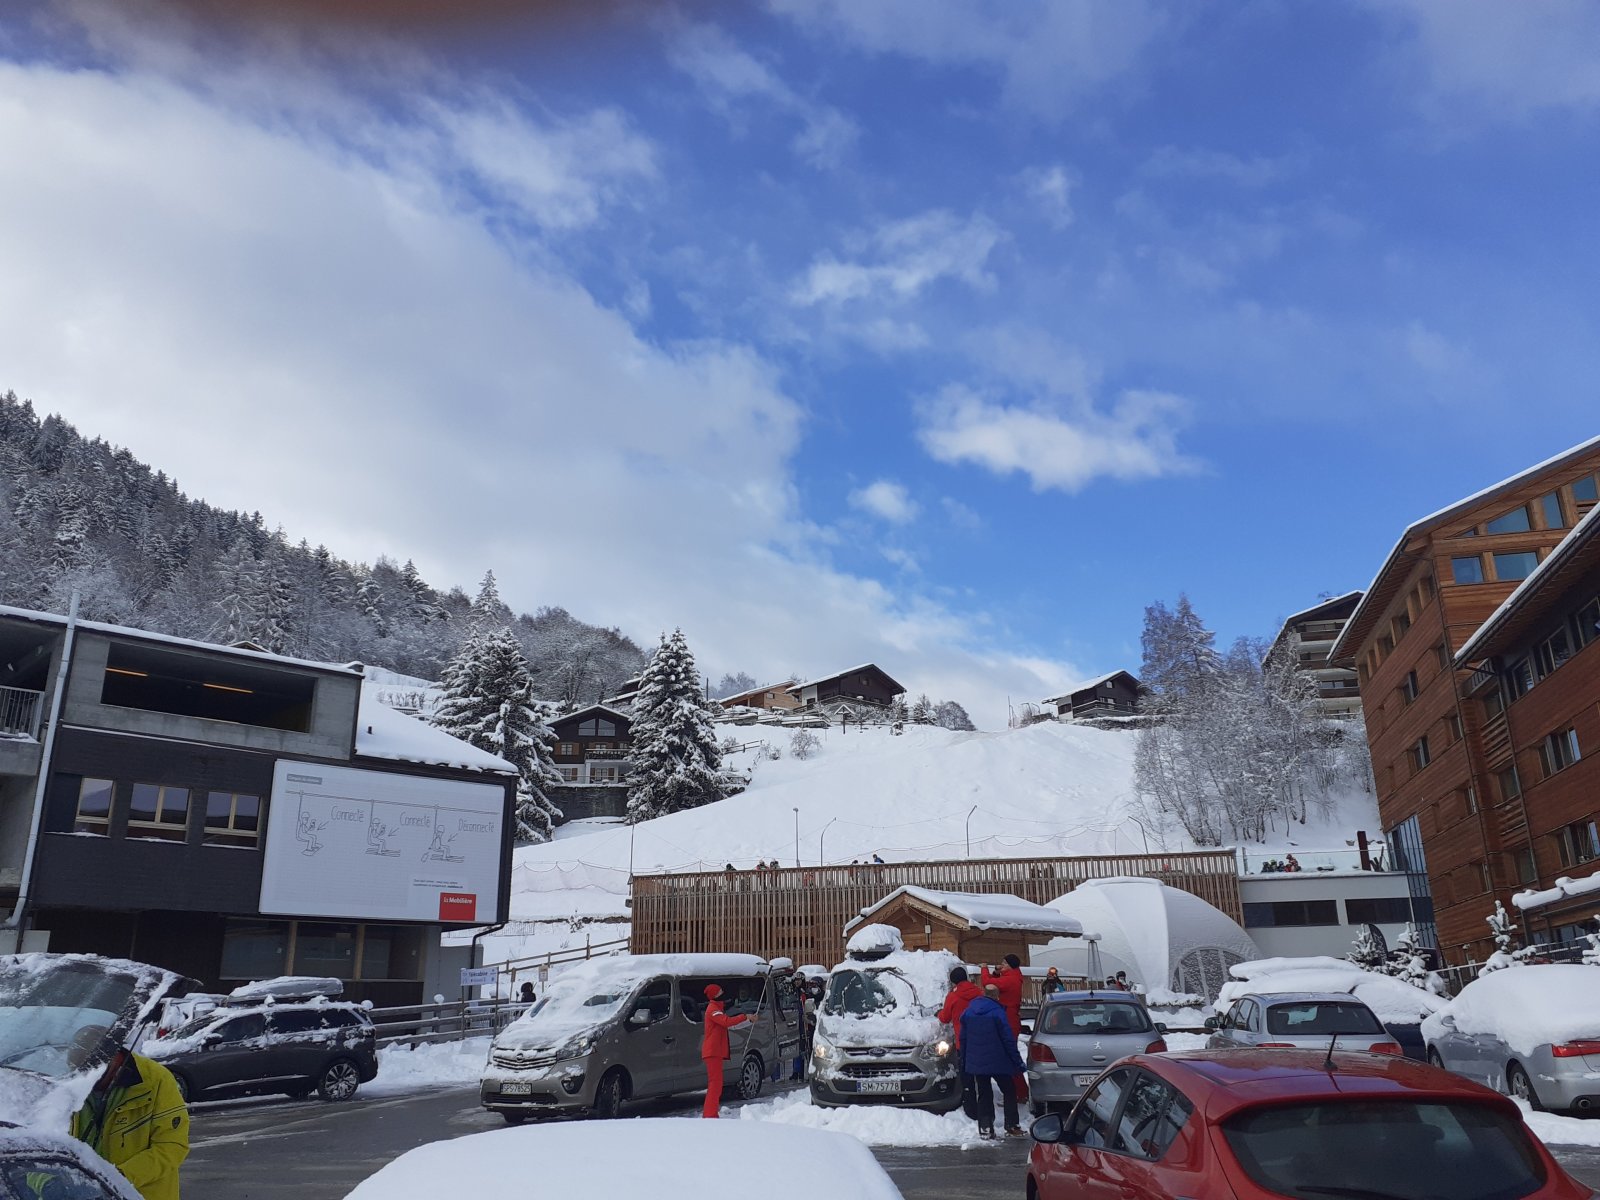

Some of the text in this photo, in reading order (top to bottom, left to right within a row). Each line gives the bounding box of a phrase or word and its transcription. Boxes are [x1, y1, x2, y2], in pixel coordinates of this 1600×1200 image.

[331, 805, 365, 822] Connecté
[400, 811, 431, 828] Connecté
[458, 818, 495, 833] Déconnecté
